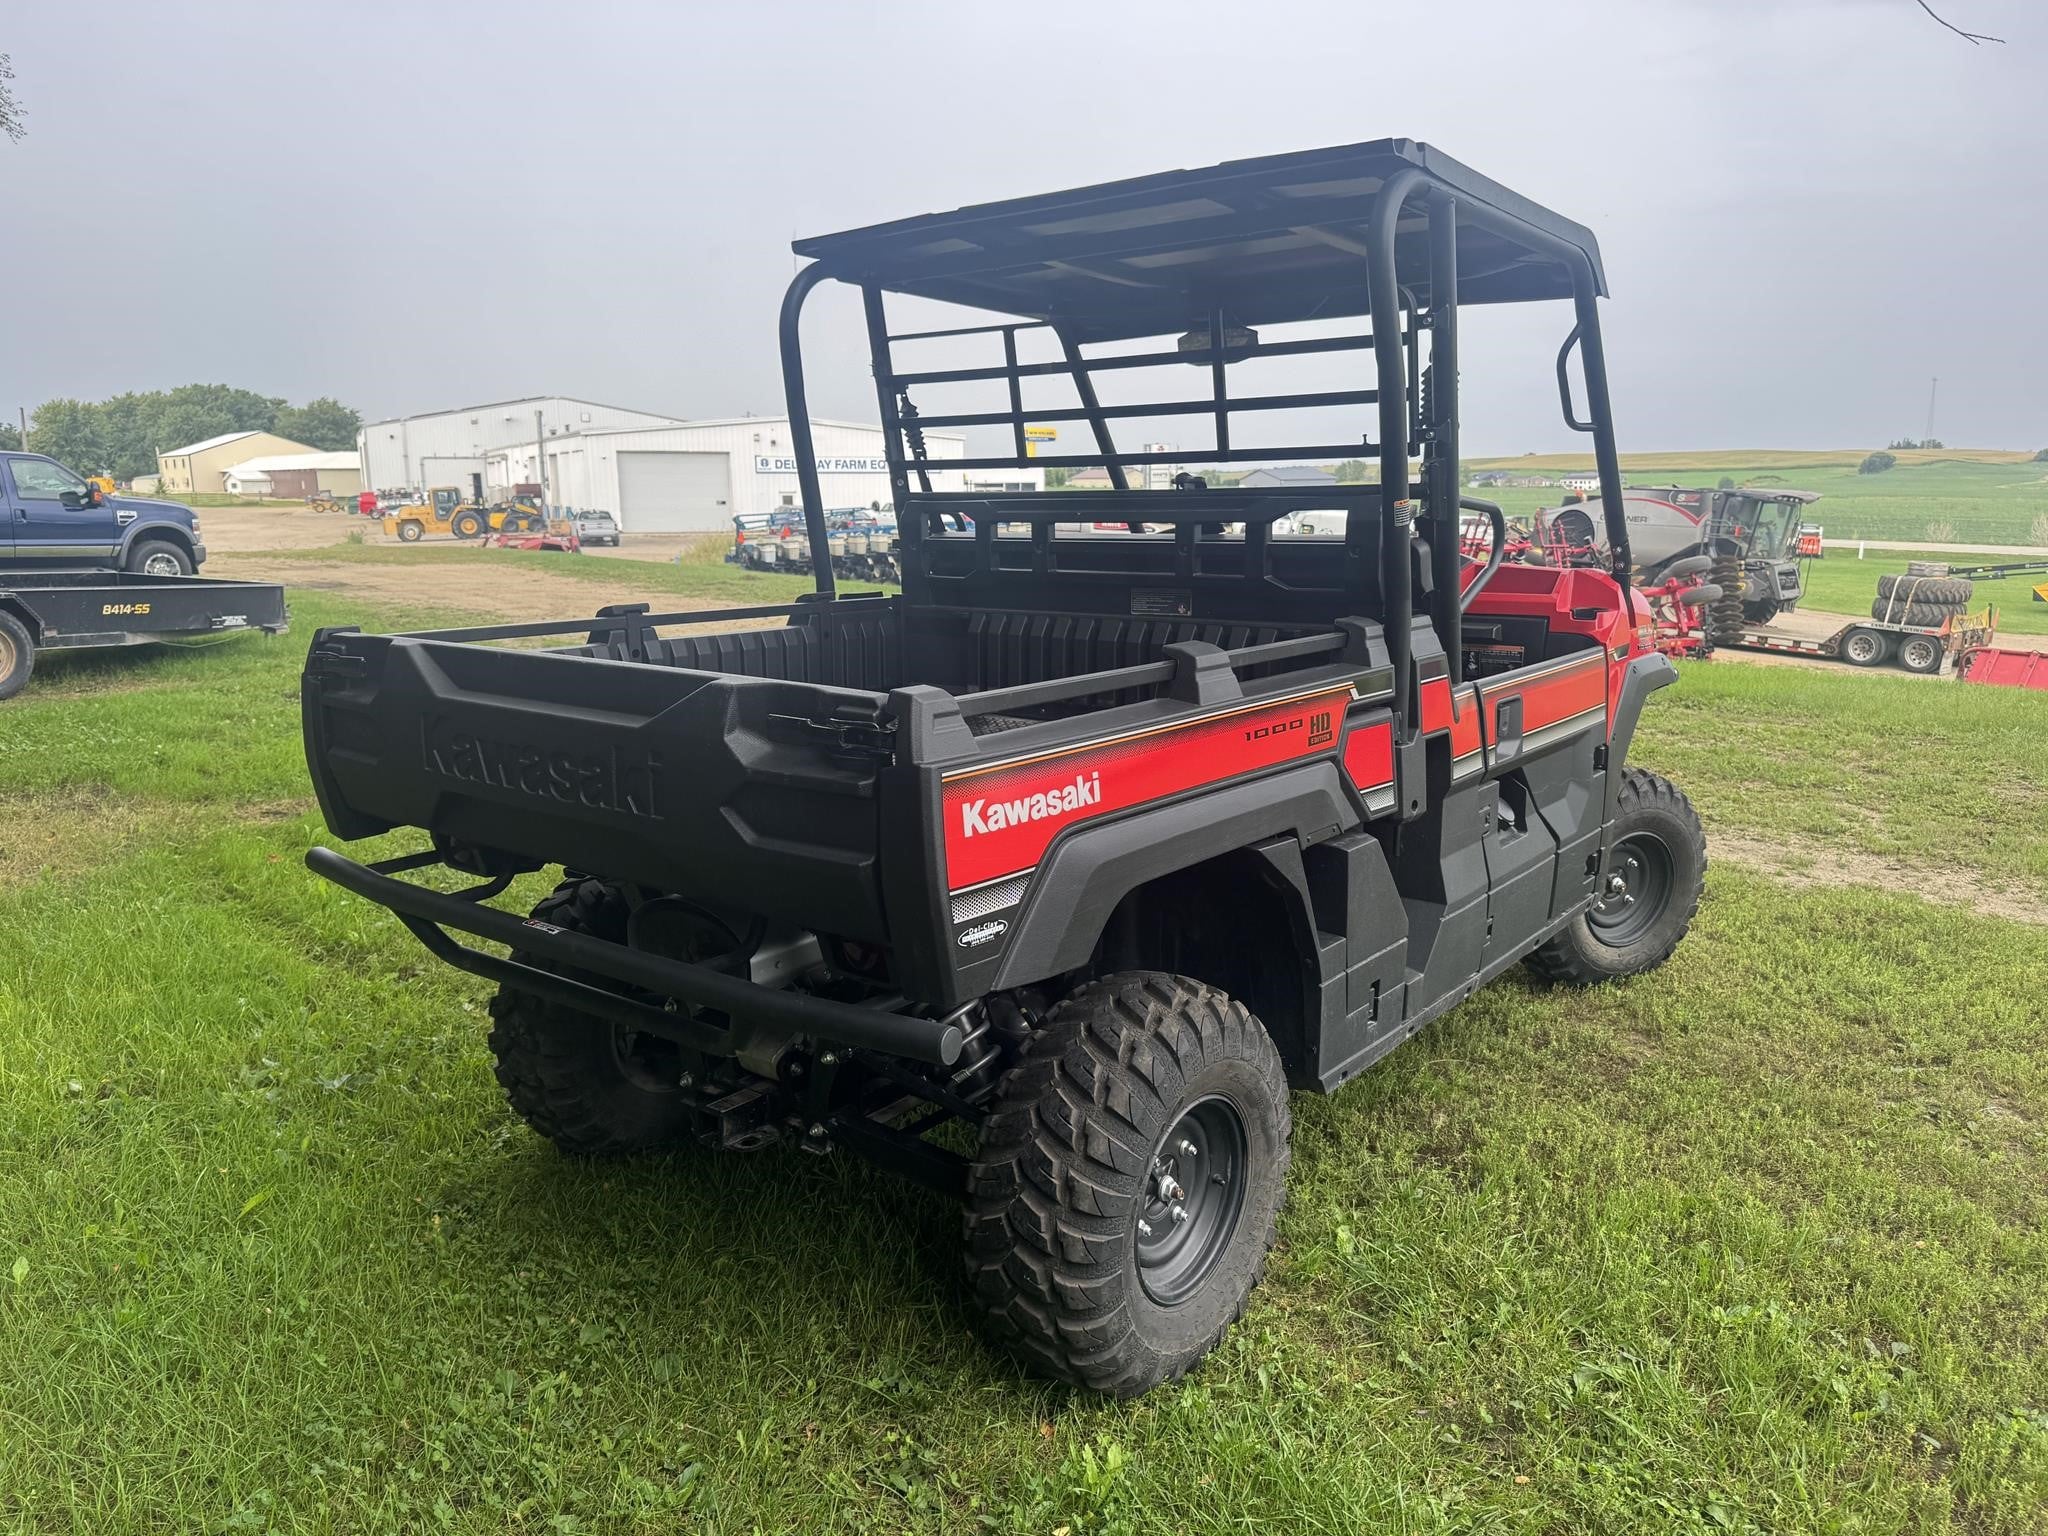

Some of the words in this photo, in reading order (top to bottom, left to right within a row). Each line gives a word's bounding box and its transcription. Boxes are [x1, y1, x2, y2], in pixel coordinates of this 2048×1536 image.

[775, 459, 832, 470] DELAY
[835, 459, 867, 470] FARM
[1244, 719, 1303, 741] 1000
[1310, 712, 1331, 735] HD
[1309, 733, 1332, 745] EDITION
[419, 711, 666, 821] Kawasaki
[962, 771, 1101, 838] Kawasaki
